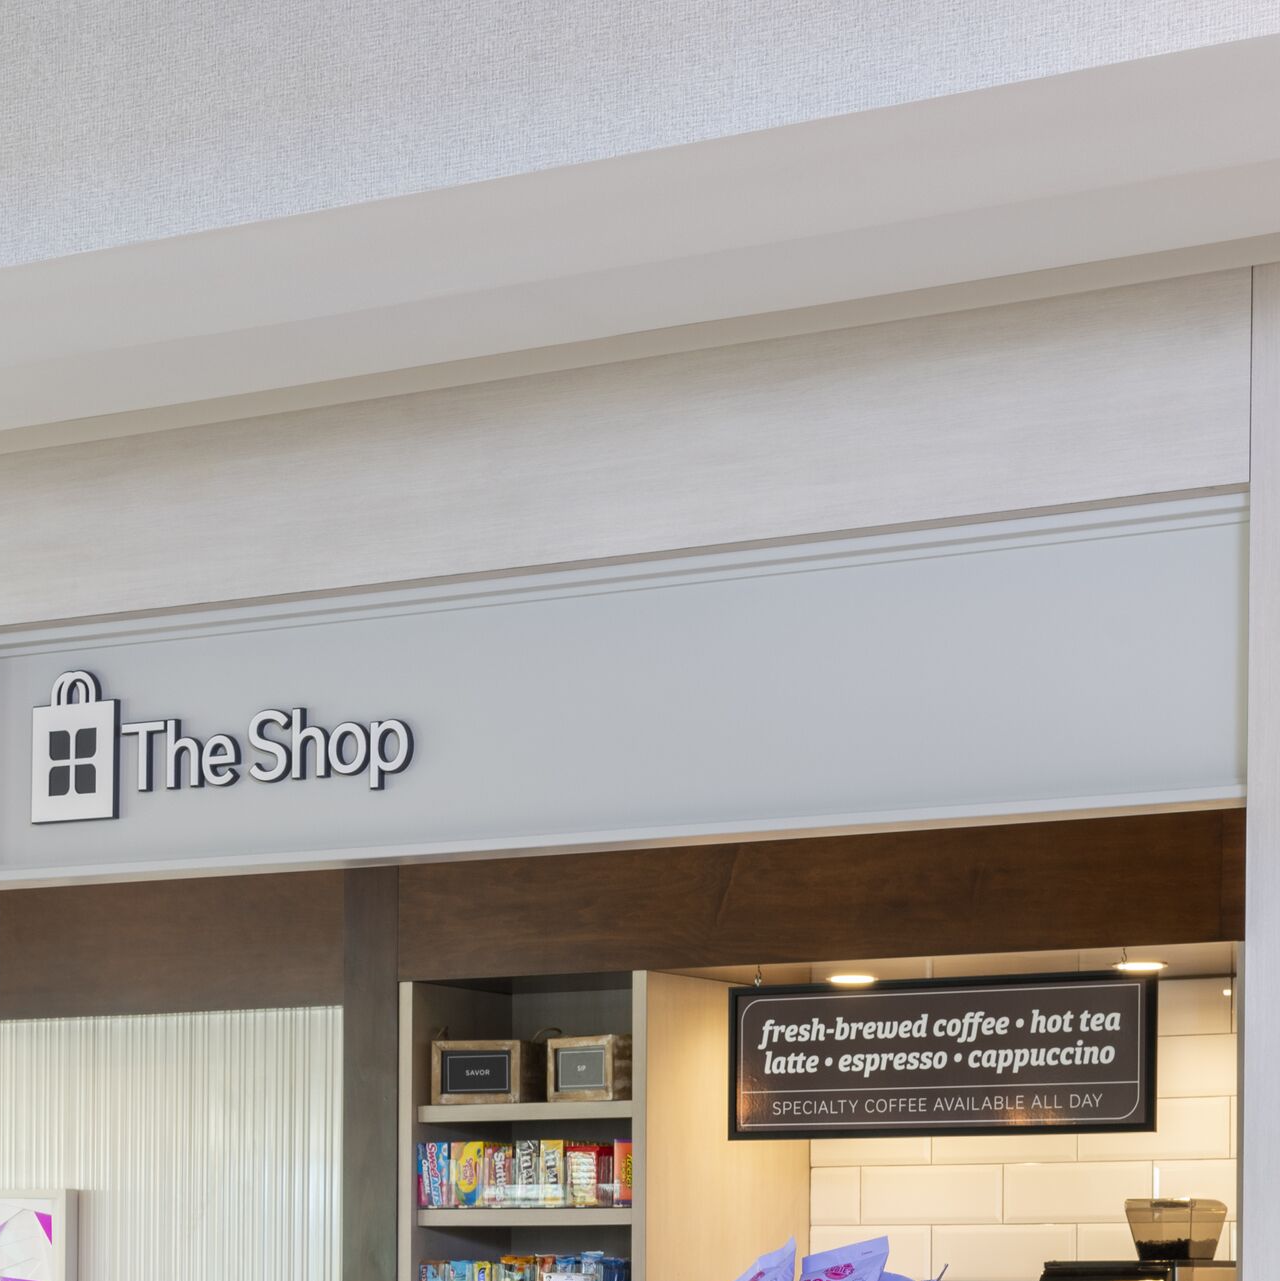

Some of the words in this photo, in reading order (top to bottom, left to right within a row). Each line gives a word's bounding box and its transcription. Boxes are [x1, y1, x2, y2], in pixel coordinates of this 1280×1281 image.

[121, 718, 241, 791] The
[248, 707, 414, 790] Shop
[758, 1013, 927, 1050] fresh-brewed
[933, 1010, 1009, 1042] coffee
[1030, 1009, 1074, 1034] hot
[1079, 1011, 1121, 1032] tea
[465, 1069, 490, 1077] SAVOR
[763, 1051, 818, 1075] latte
[838, 1051, 948, 1078] espresso
[967, 1040, 1115, 1074] cappuccino
[772, 1100, 859, 1116] SPECIALTY
[863, 1097, 927, 1114] COFFEE
[933, 1095, 1025, 1112] AVAILABLE
[1030, 1094, 1063, 1109] ALL
[1069, 1093, 1103, 1109] DAY
